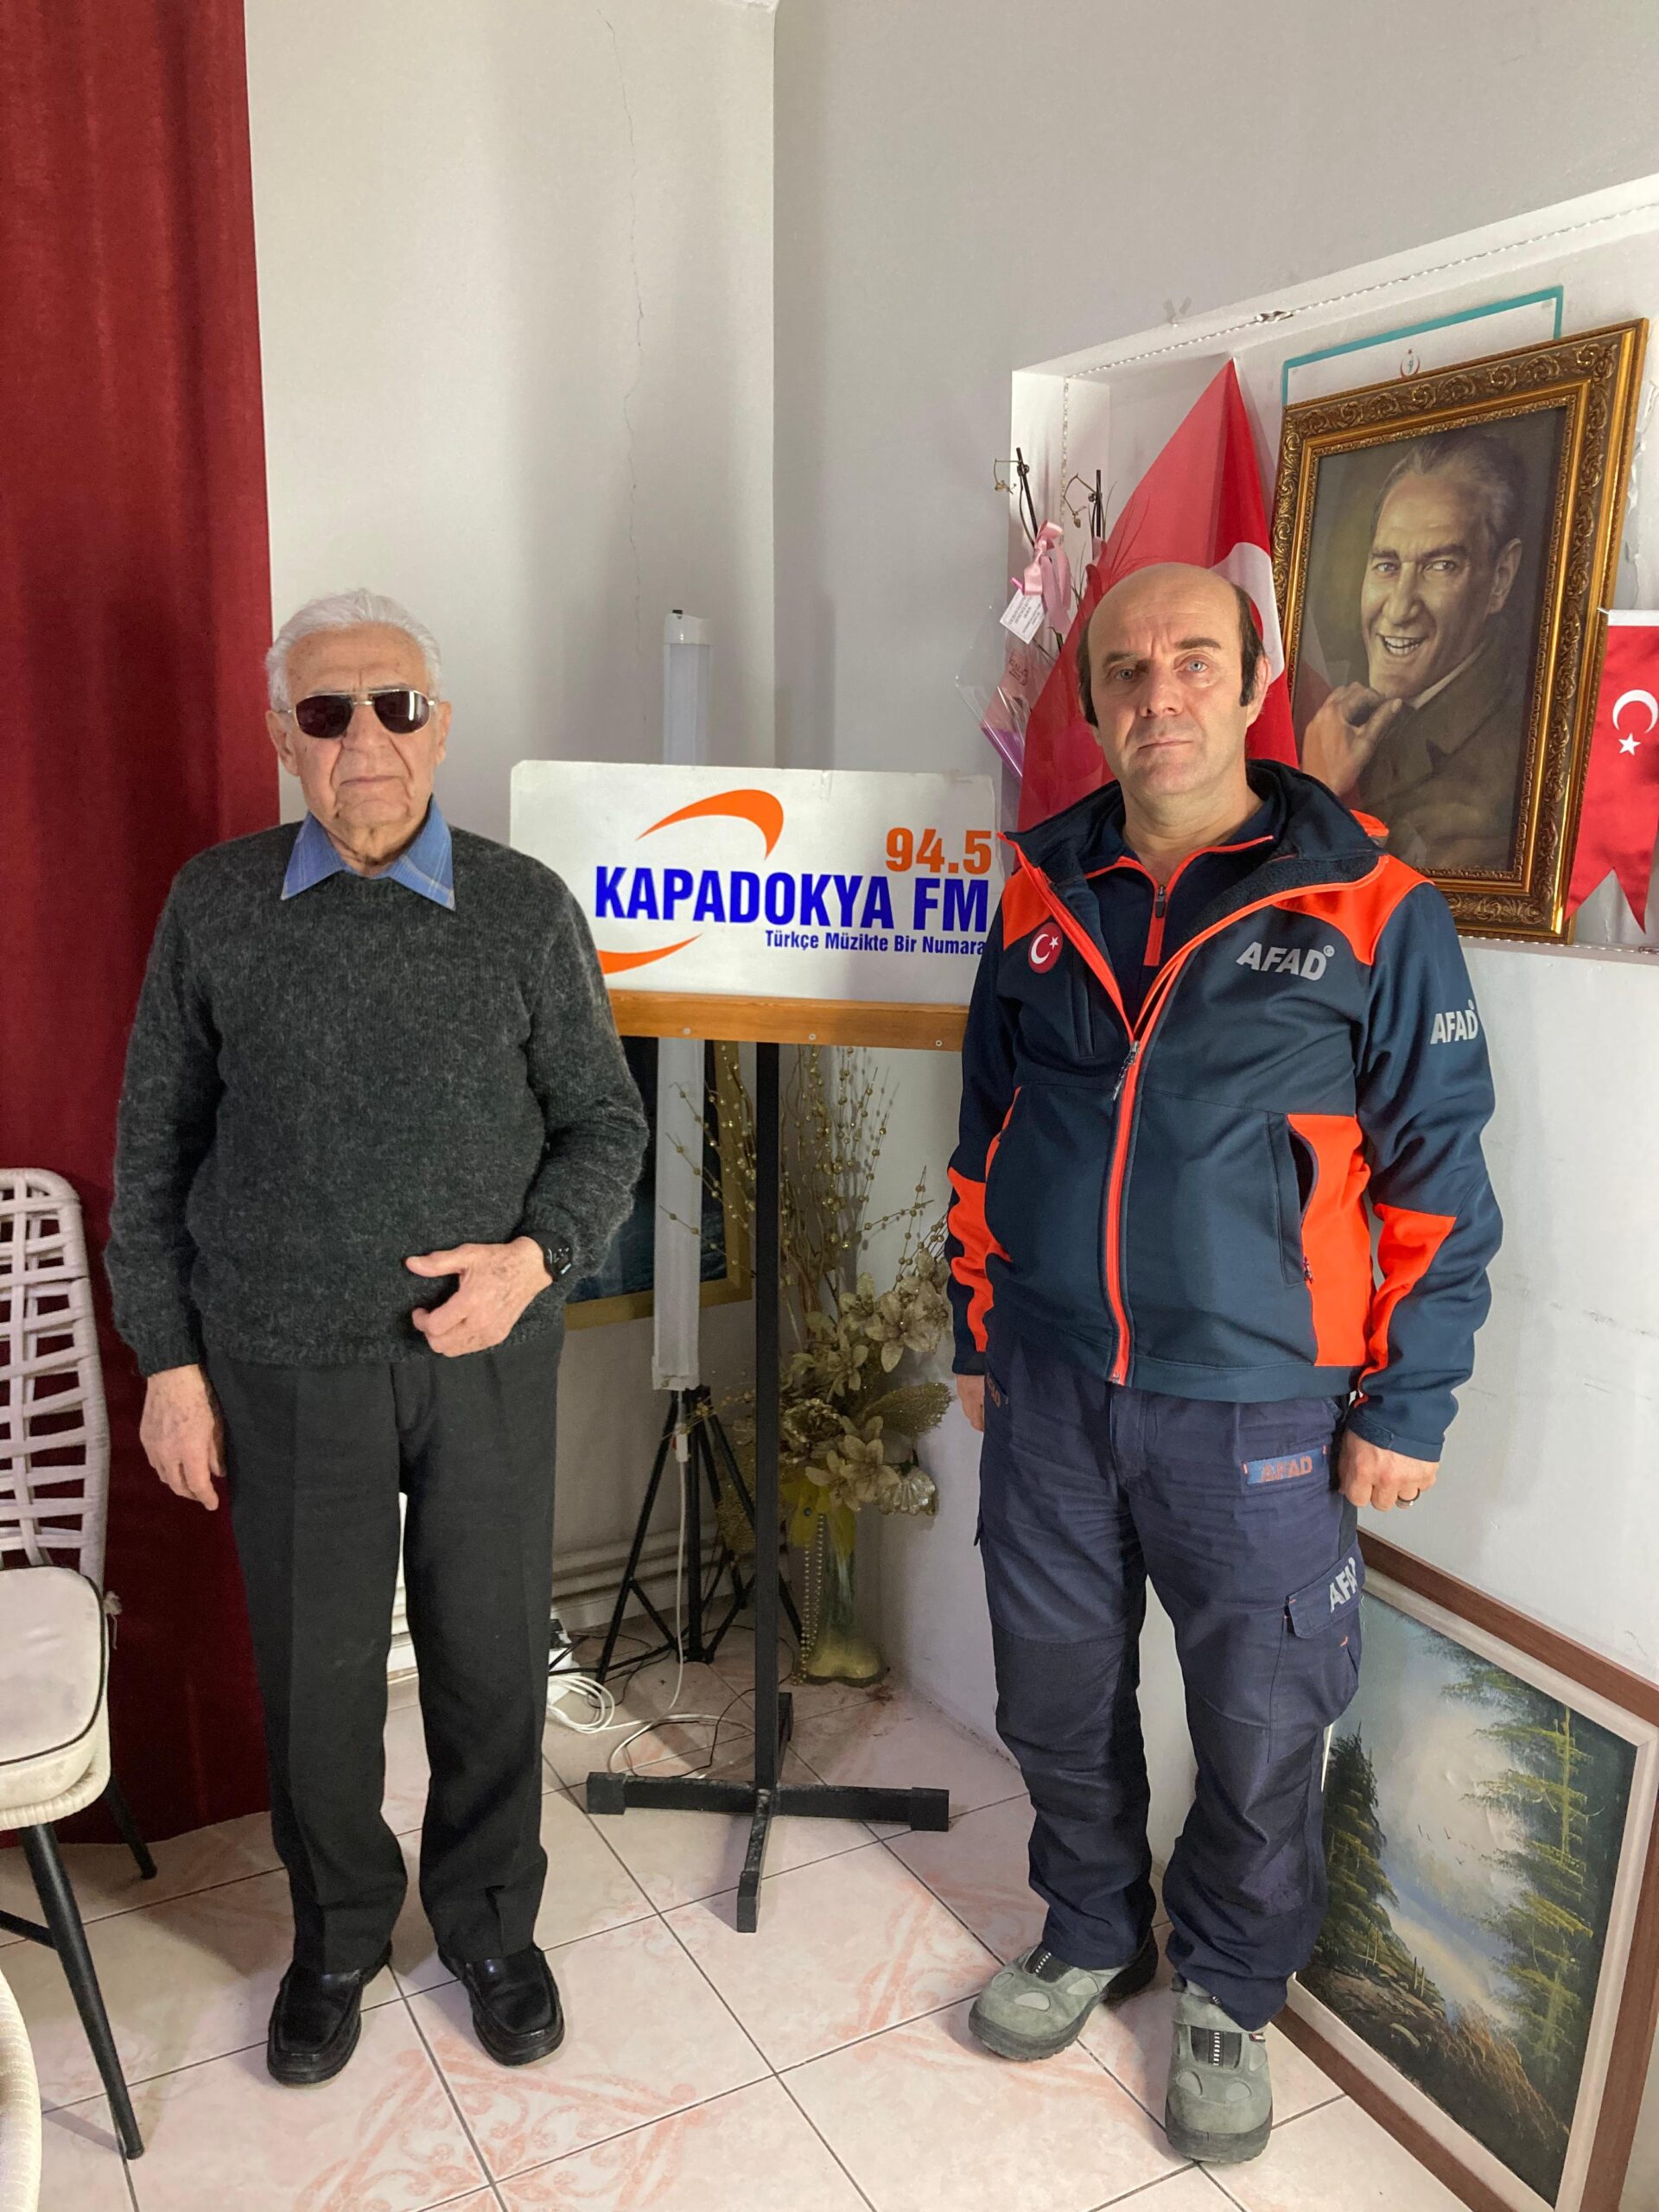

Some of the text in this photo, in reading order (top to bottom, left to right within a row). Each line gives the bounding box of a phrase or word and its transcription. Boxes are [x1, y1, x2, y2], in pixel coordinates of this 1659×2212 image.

[886, 827, 992, 874] 94.5
[594, 865, 989, 933] KAPADOKYA FM
[766, 930, 986, 955] Türkçe Müzikte Bir Numara
[1236, 941, 1327, 981] AFAD
[1430, 1009, 1478, 1045] AFAD
[1260, 1455, 1313, 1482] AFAD
[1329, 1559, 1358, 1613] AFA
